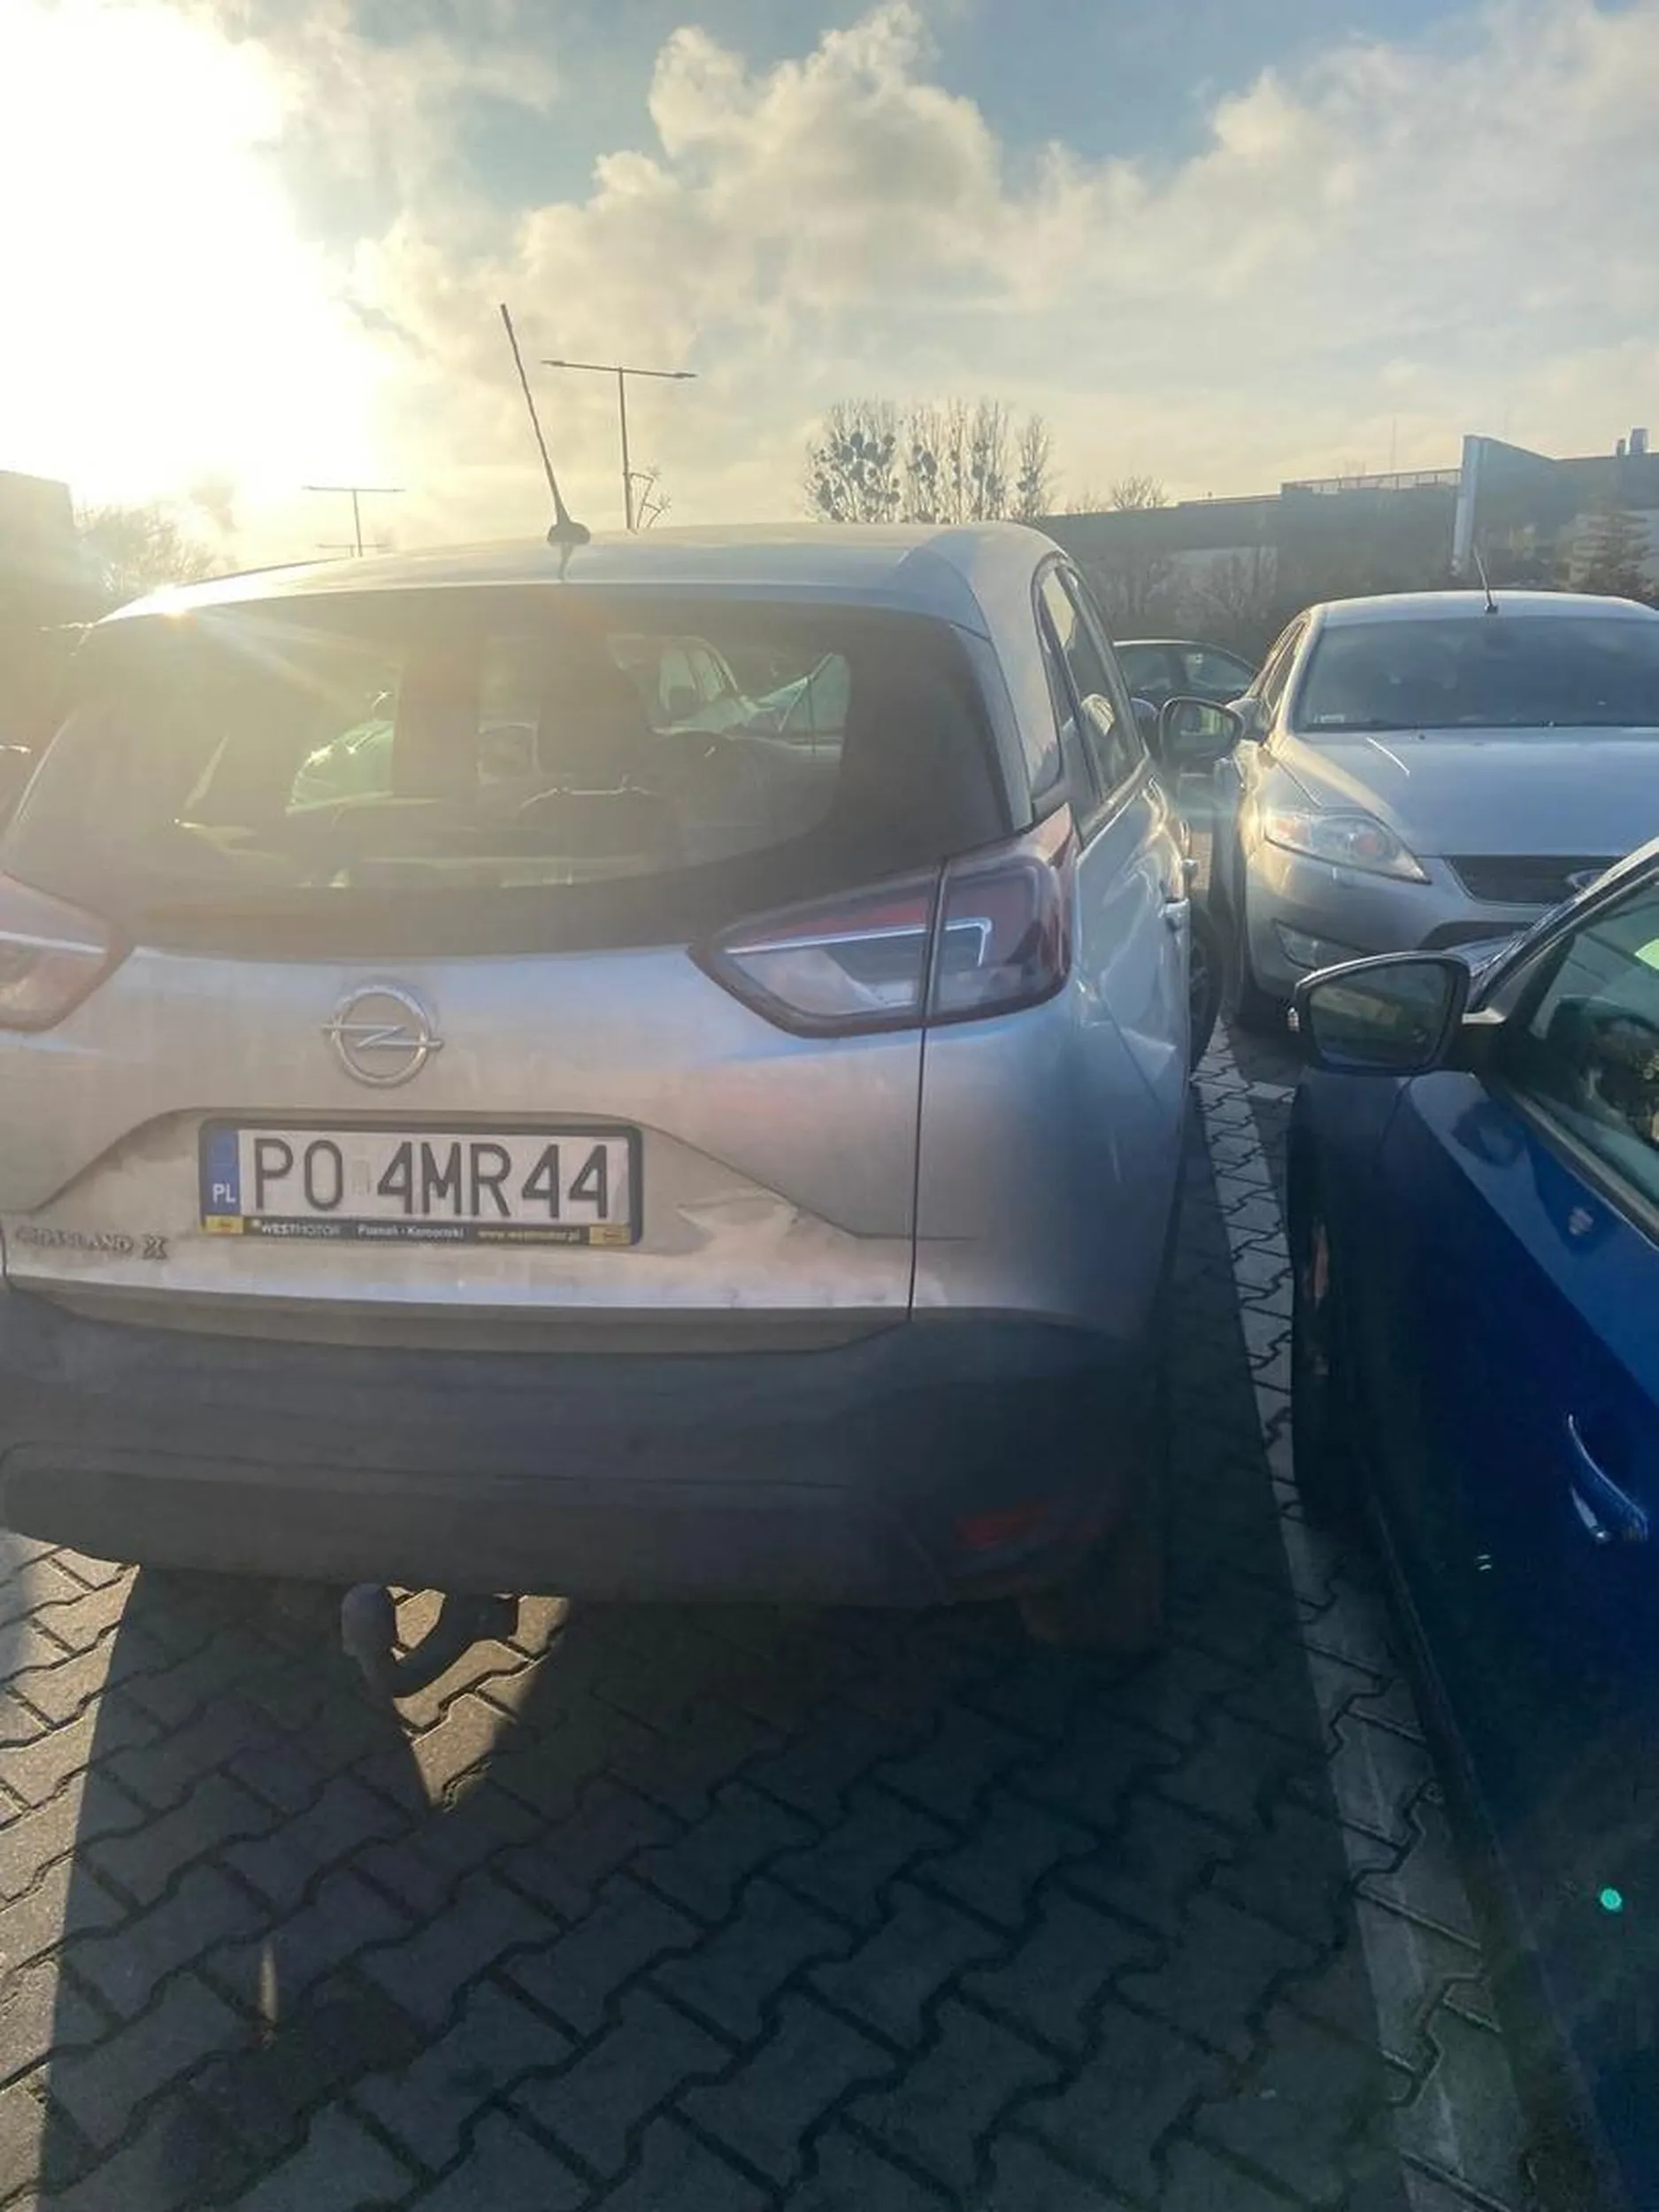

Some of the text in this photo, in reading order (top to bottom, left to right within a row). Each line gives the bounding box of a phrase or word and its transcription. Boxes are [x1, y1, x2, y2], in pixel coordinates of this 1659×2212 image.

[213, 1185, 236, 1204] PL
[253, 1138, 609, 1220] PO 4MR44
